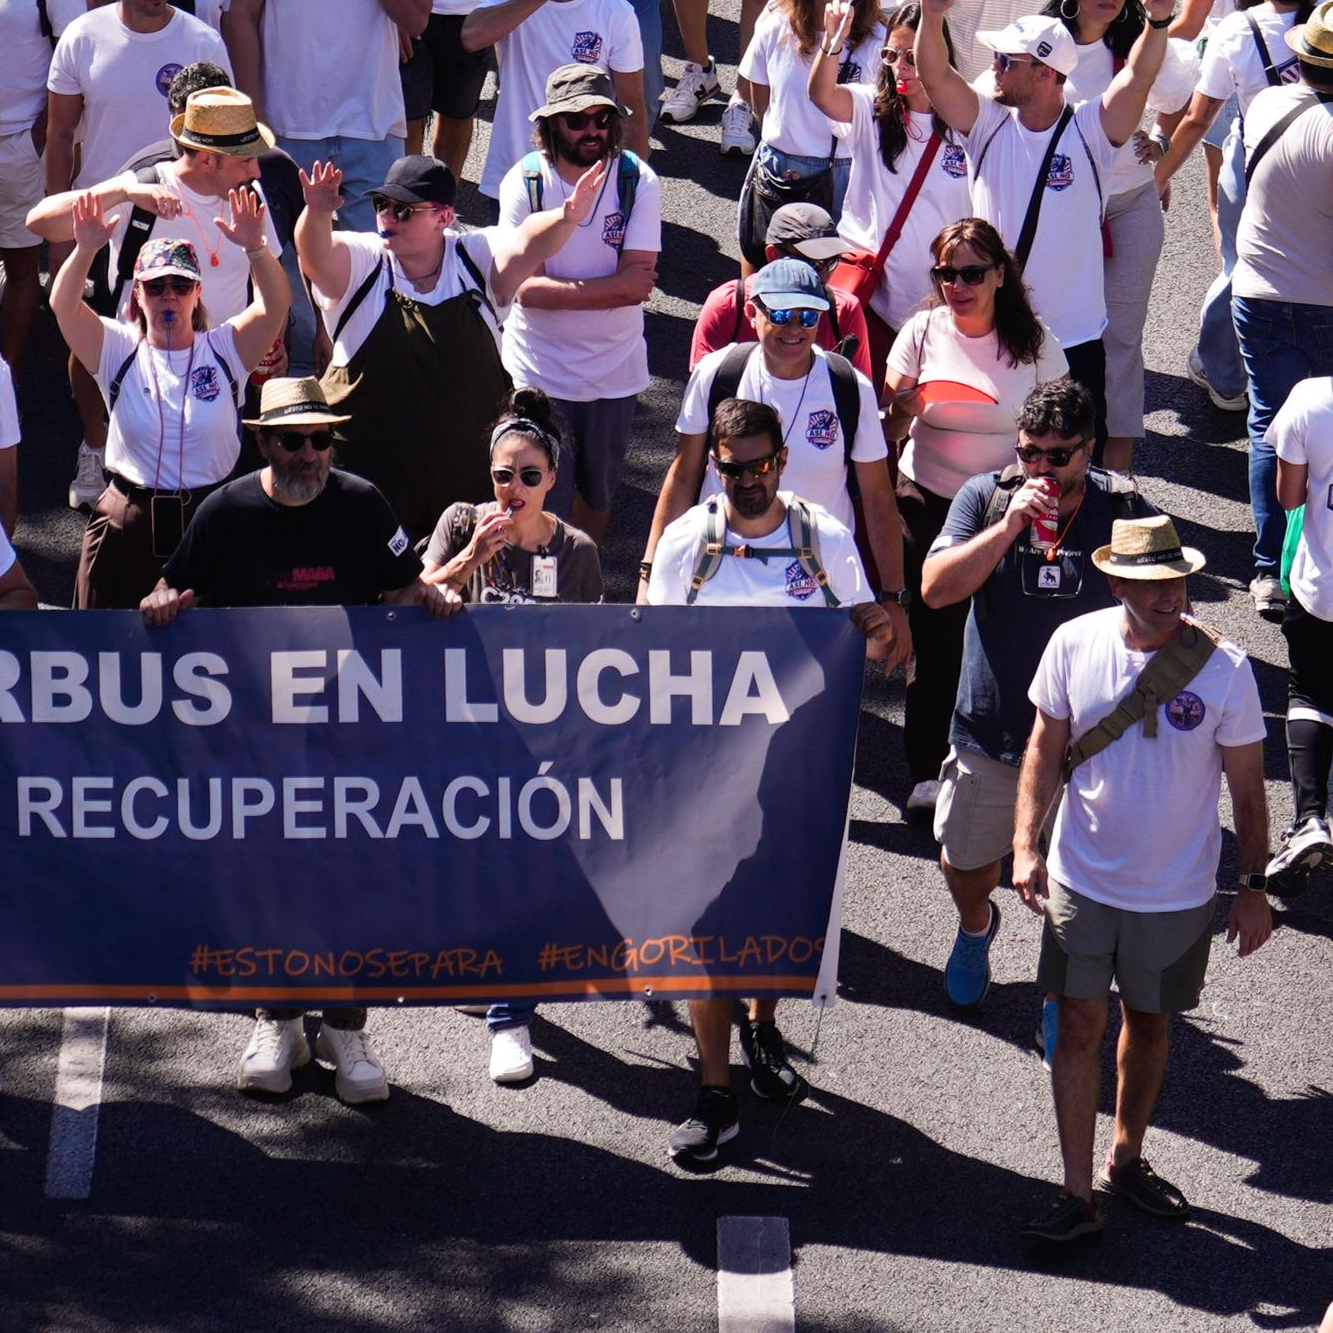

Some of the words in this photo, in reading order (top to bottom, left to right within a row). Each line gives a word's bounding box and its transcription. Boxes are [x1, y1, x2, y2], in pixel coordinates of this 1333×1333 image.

[270, 648, 403, 724] EN
[444, 647, 792, 726] LUCHA
[18, 760, 625, 841] RECUPERACIÓN
[191, 944, 503, 978] #ESTONOSEPARA
